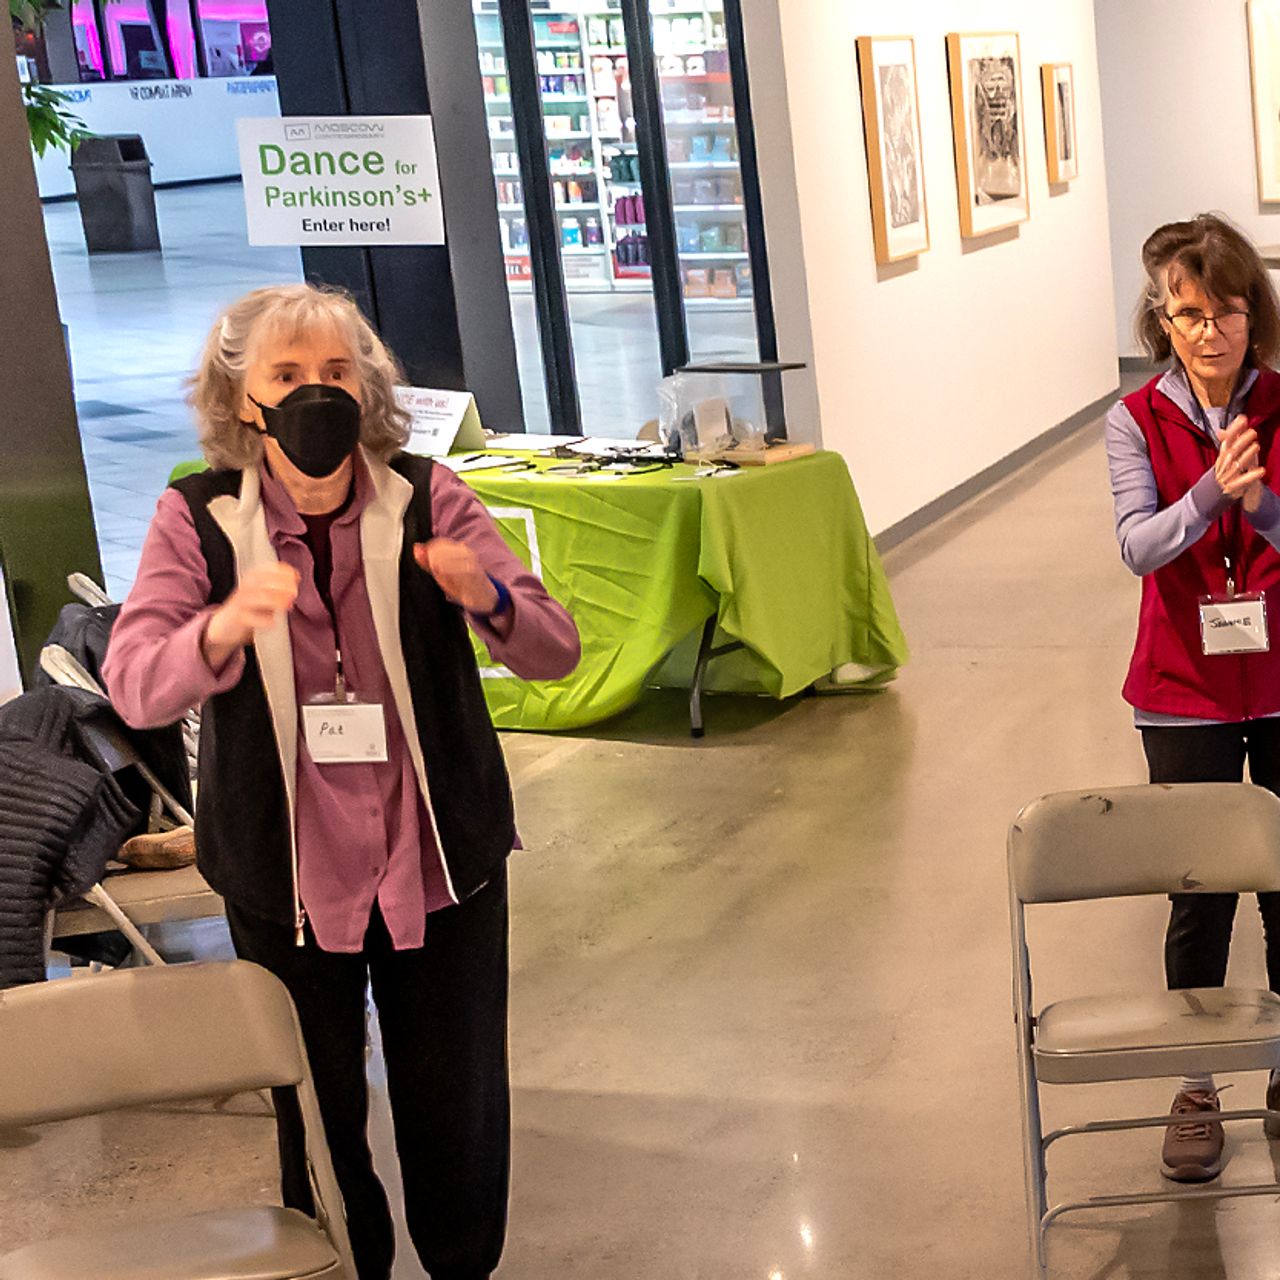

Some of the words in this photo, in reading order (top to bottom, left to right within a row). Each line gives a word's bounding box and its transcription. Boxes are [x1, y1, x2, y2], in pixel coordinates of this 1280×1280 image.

[258, 144, 385, 176] Dance
[395, 160, 418, 175] for
[264, 184, 432, 208] Parkinson's+
[302, 218, 346, 232] Enter
[349, 217, 391, 232] here!
[319, 721, 344, 736] Pat
